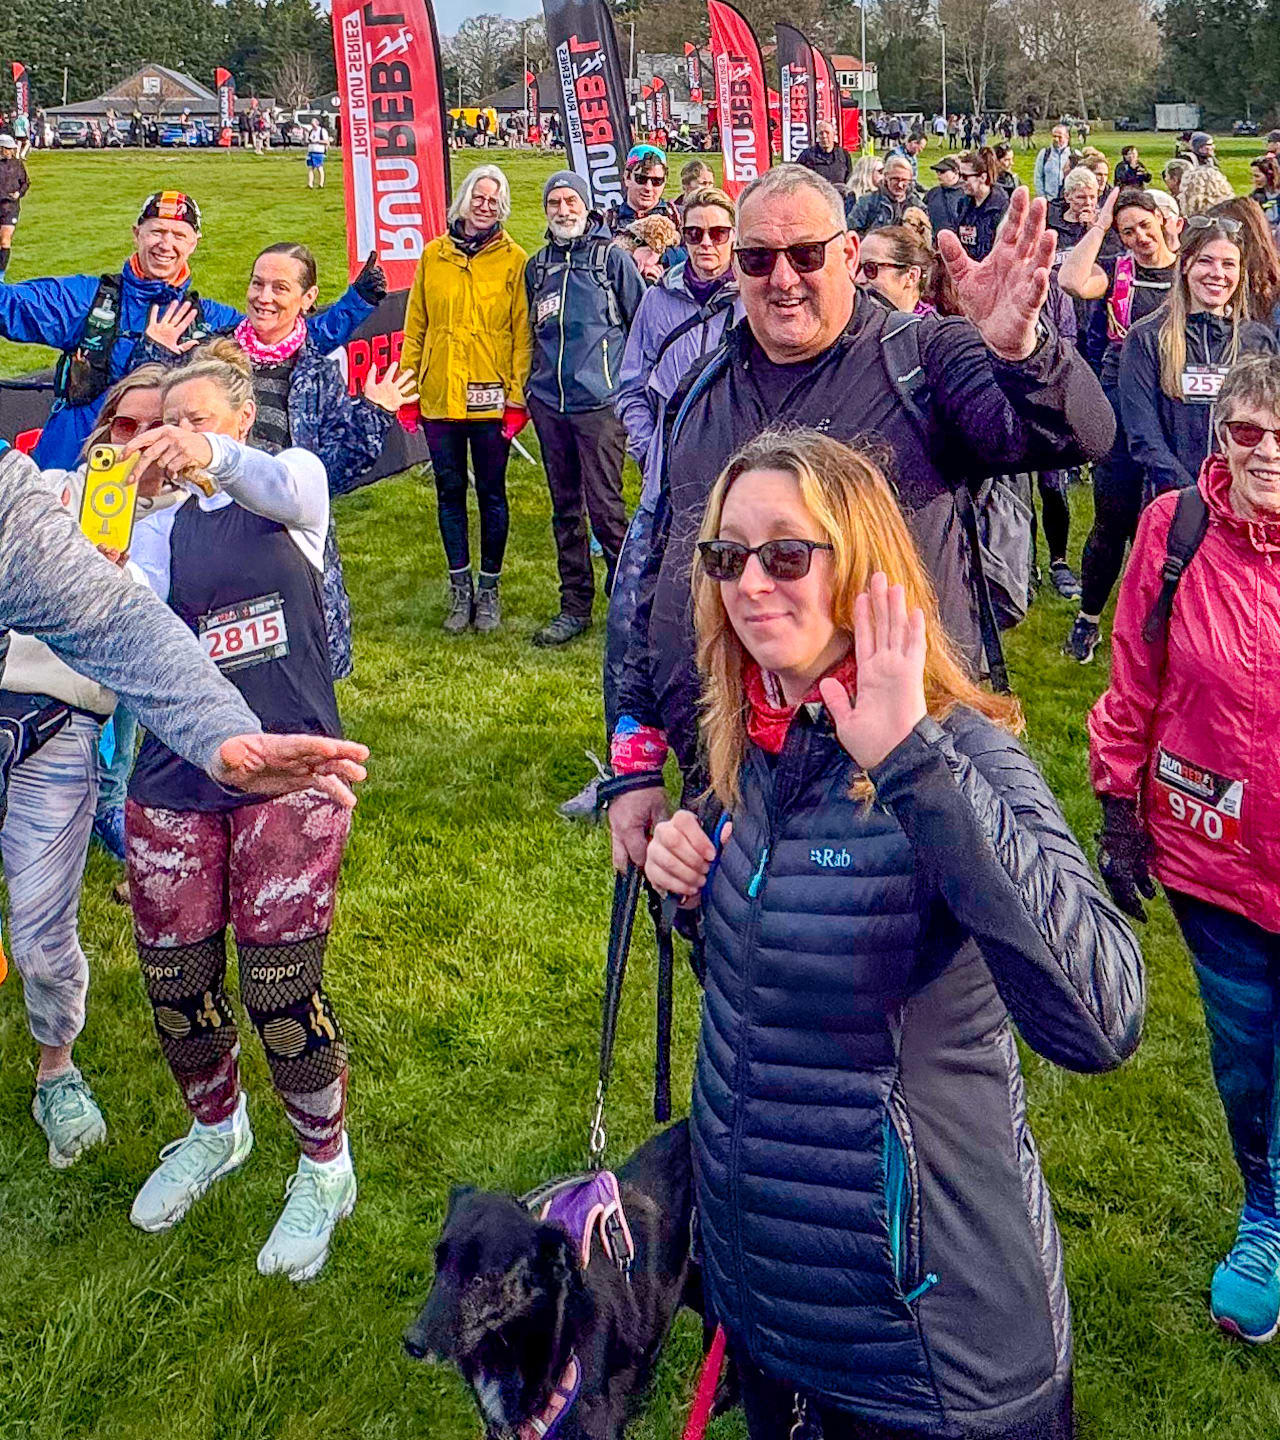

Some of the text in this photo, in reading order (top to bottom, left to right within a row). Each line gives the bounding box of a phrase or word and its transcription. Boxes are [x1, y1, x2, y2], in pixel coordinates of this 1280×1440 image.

[467, 390, 500, 404] 2832
[206, 616, 279, 658] 2815
[1168, 792, 1223, 840] 970
[821, 848, 851, 868] Rab
